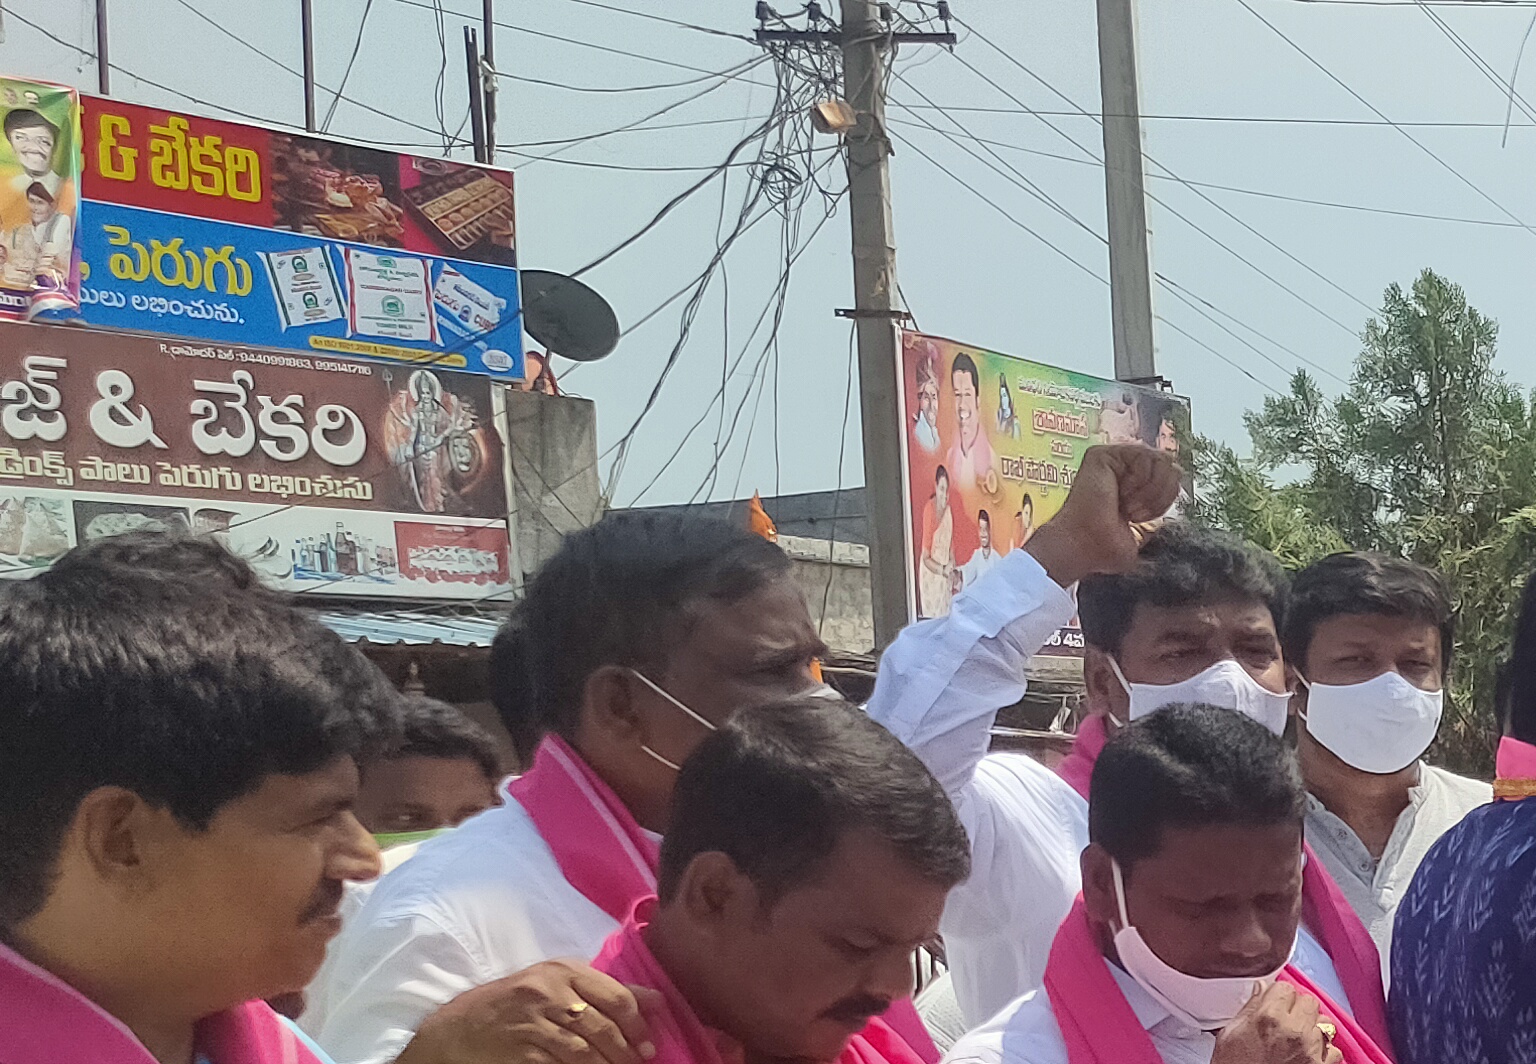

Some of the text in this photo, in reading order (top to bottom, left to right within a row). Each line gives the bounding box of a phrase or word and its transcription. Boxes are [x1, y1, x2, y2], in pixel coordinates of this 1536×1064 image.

[98, 114, 262, 203] & బేకరి
[103, 224, 253, 297] పెరుగు
[90, 369, 169, 450] &
[191, 369, 367, 467] బేకరి
[78, 456, 151, 485] పాలు
[155, 461, 243, 491] పెరుగు
